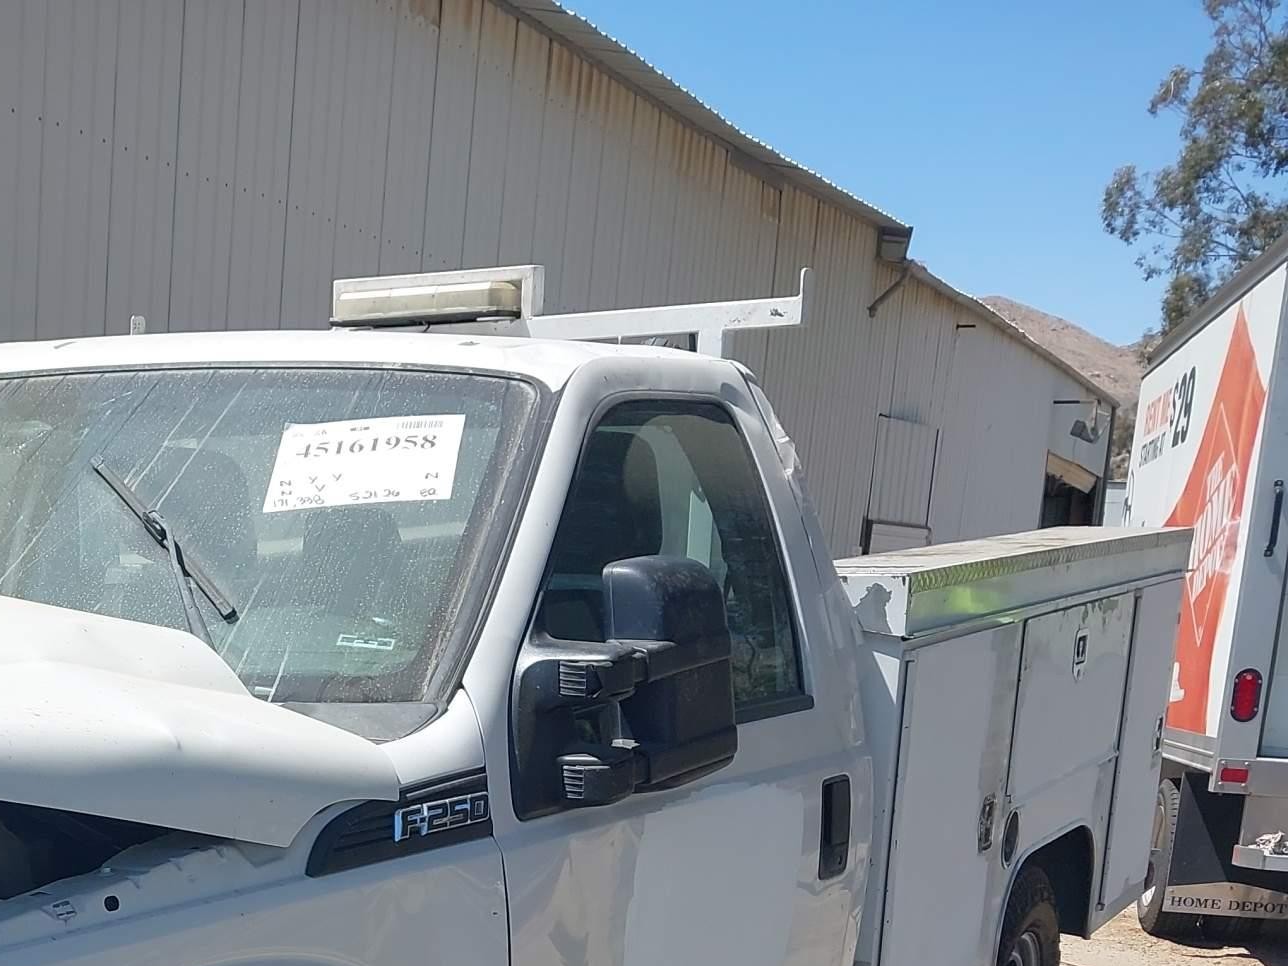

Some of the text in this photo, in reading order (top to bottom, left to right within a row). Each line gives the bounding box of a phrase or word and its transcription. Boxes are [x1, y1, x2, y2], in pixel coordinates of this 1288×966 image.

[1169, 366, 1196, 448] $29
[296, 434, 438, 458] 45161958
[394, 792, 490, 842] F-250
[1170, 896, 1288, 914] HOME DEPOT
